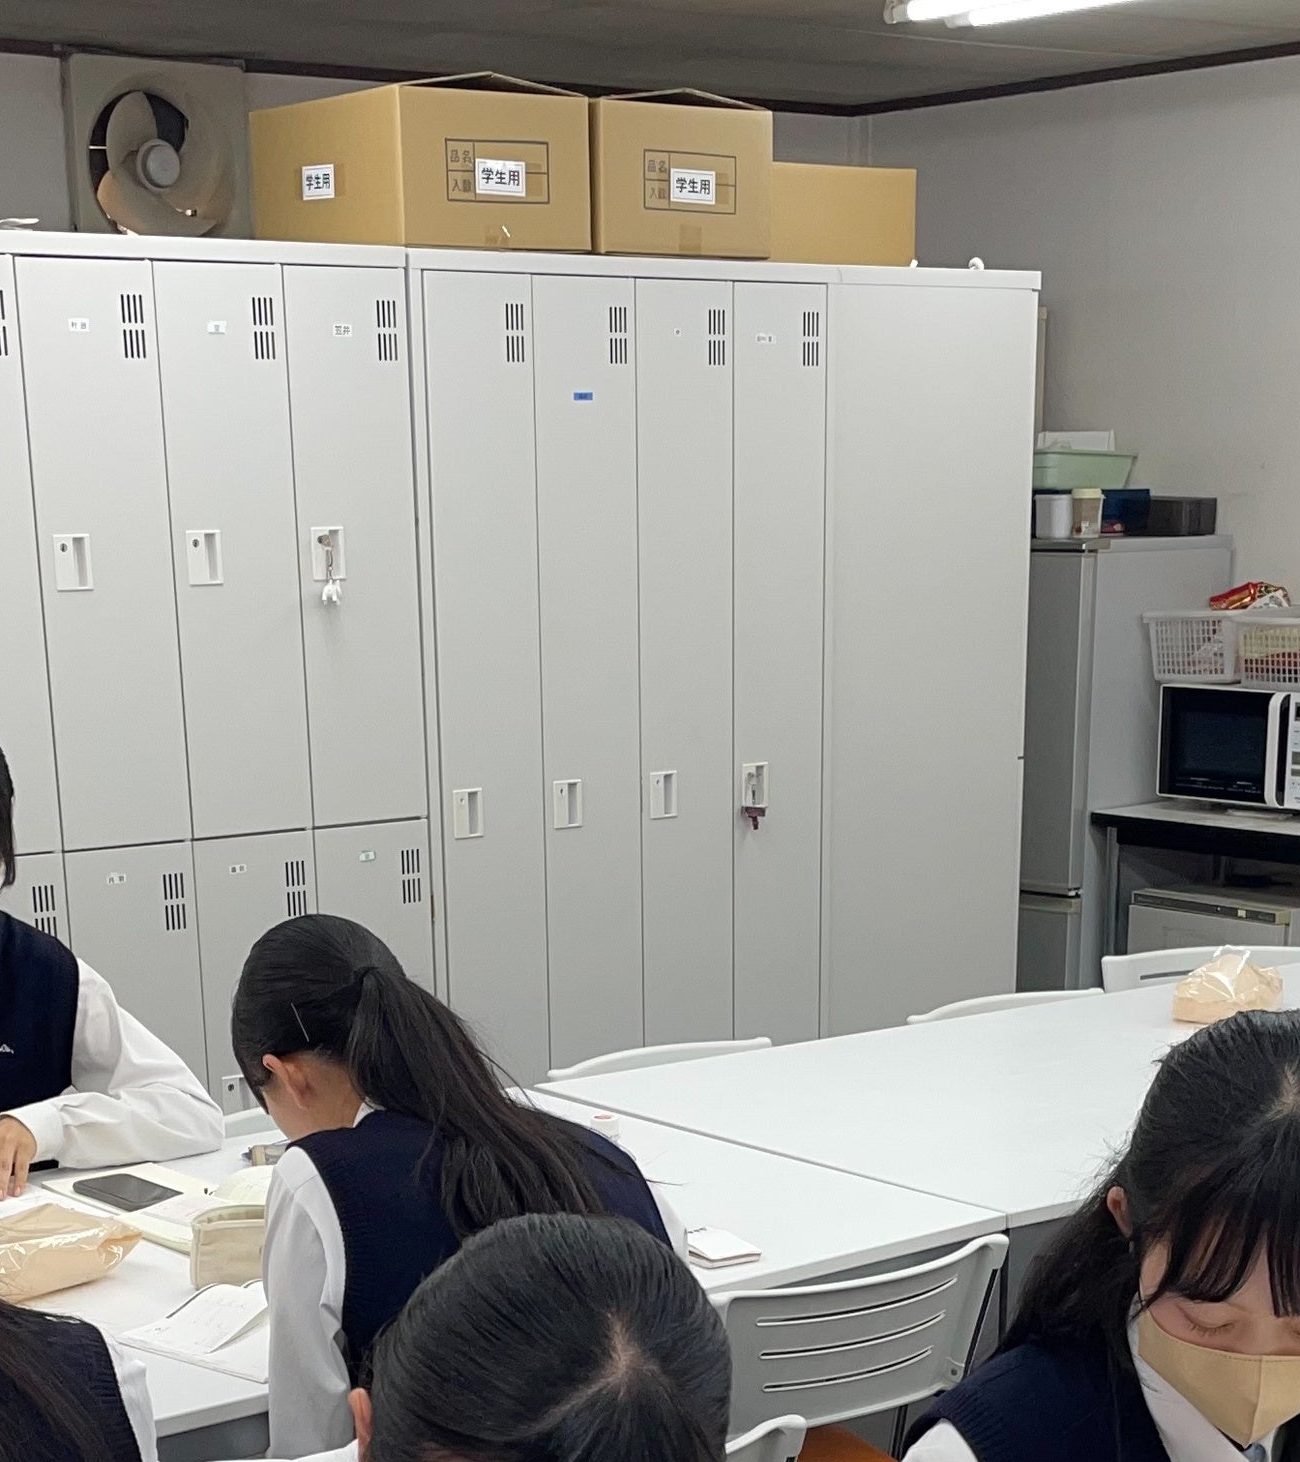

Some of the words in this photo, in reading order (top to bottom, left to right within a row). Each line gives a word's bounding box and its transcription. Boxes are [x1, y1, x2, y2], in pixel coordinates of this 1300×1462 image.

[450, 148, 472, 164] 品名
[305, 173, 331, 190] 学生用
[481, 167, 521, 187] 学生用
[675, 176, 711, 196] 学生用
